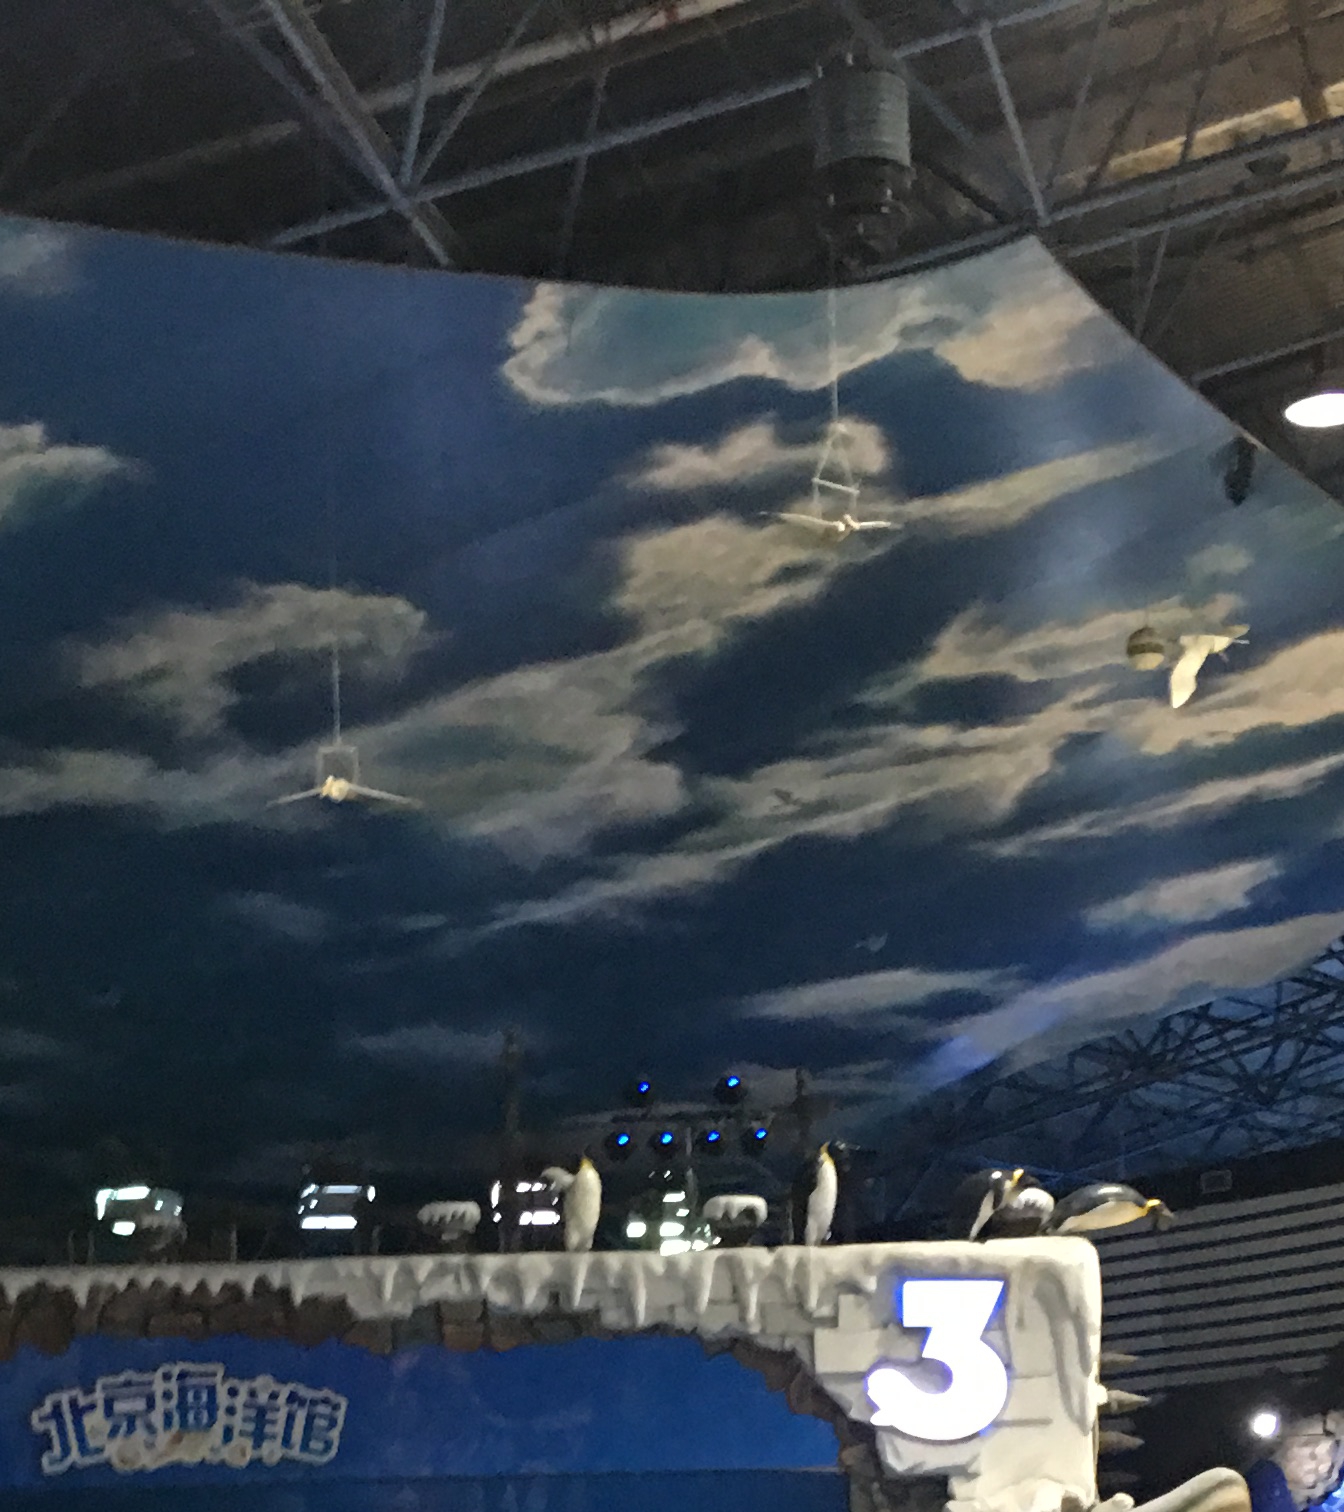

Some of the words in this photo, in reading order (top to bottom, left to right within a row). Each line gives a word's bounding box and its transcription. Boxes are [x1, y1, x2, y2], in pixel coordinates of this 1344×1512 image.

[31, 1363, 348, 1472] 北京海洋馆
[867, 1280, 1008, 1440] 3
